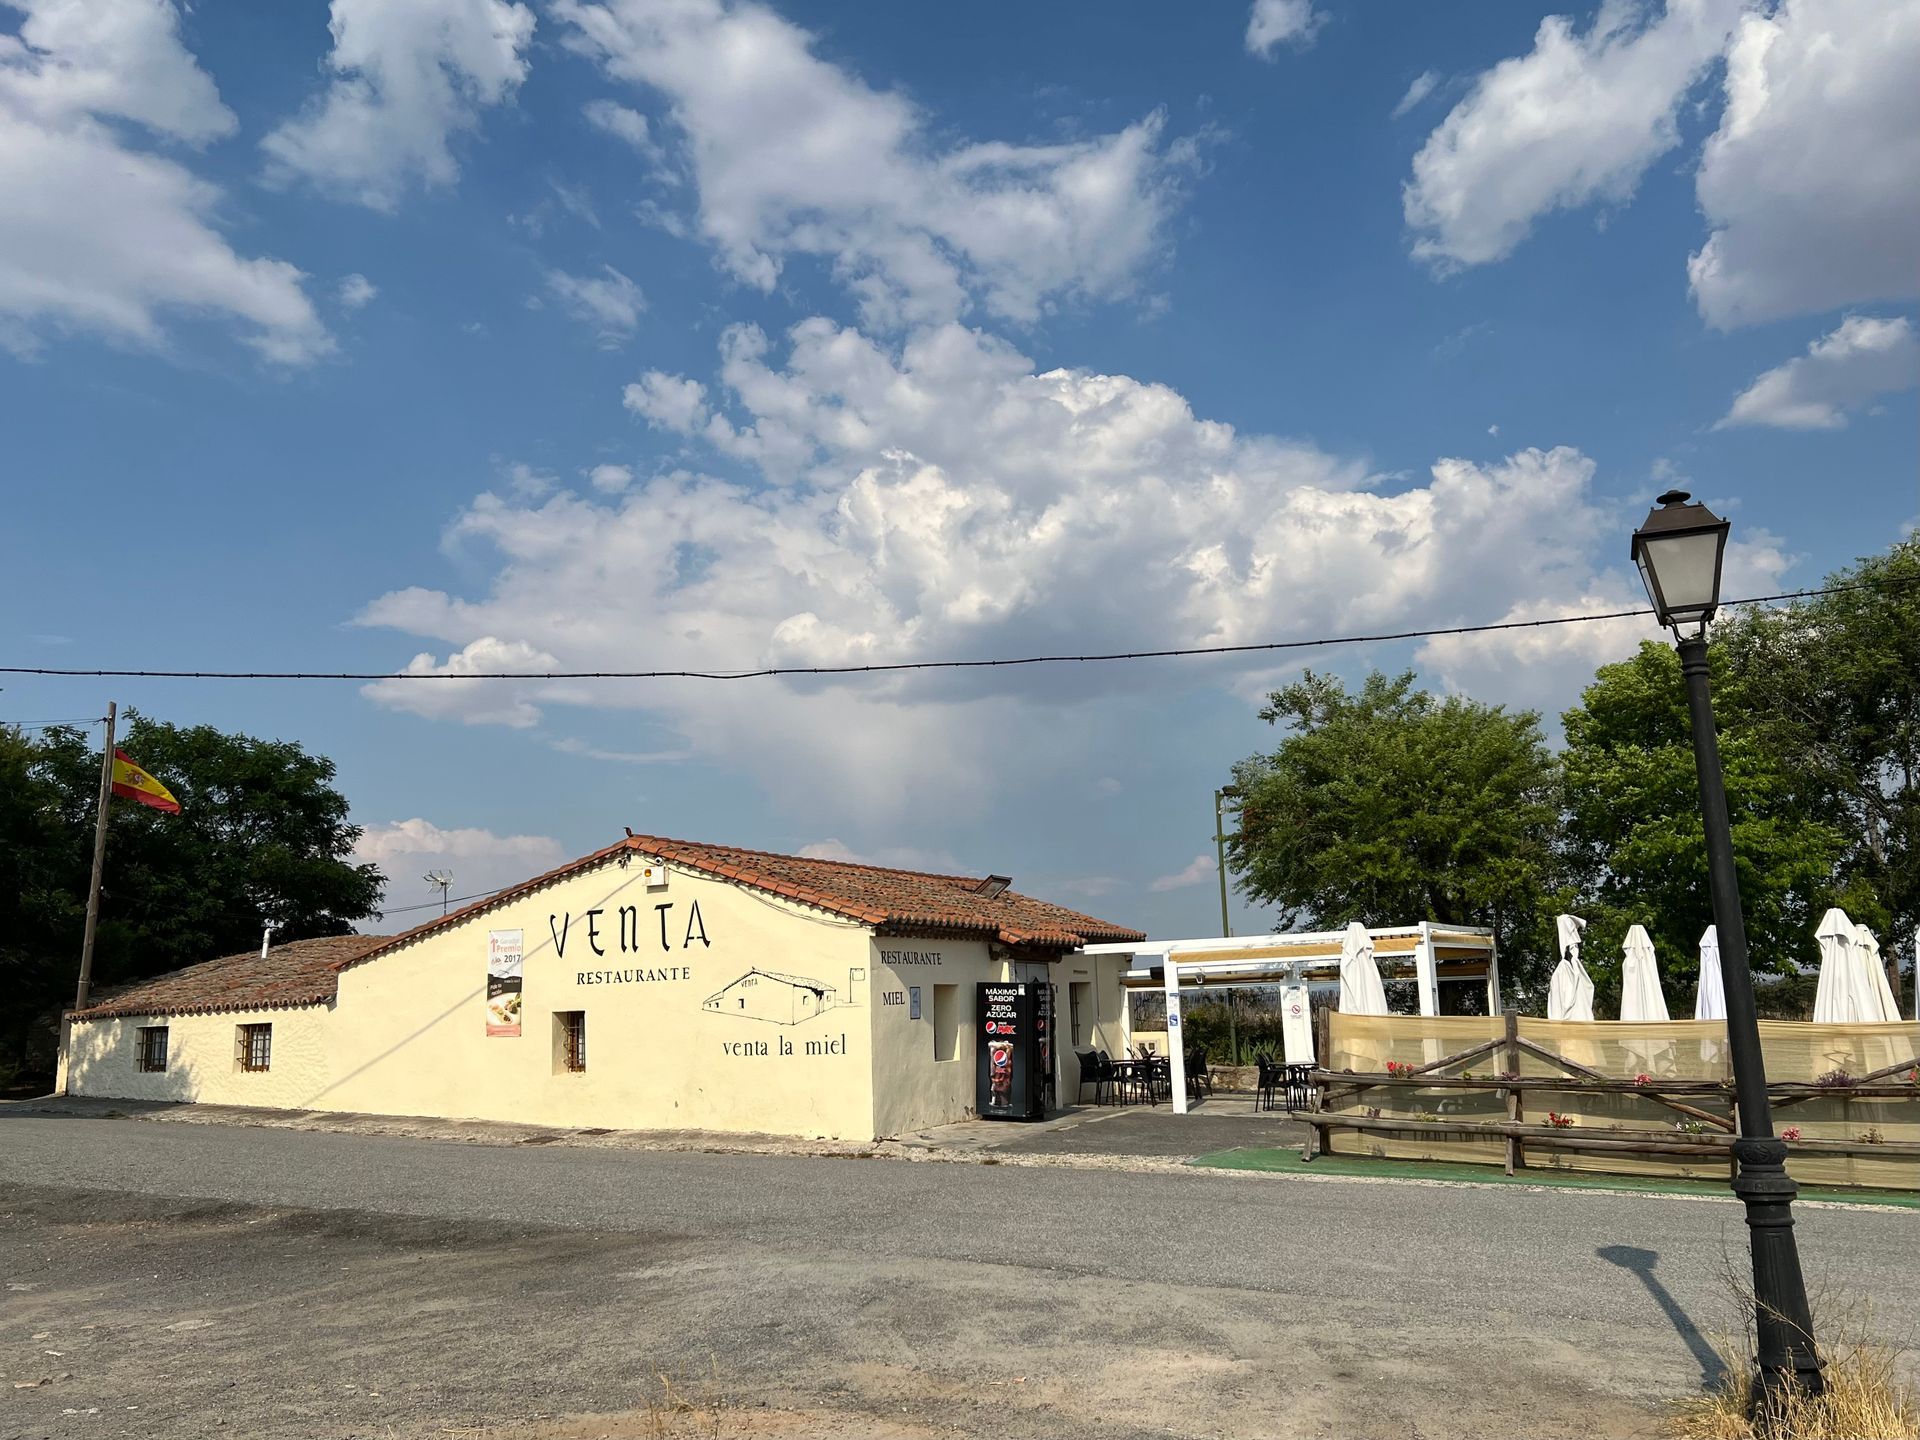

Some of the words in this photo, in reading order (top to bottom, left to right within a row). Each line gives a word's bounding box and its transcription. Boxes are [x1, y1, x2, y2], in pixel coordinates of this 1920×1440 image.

[550, 899, 711, 958] VENTA
[496, 944, 521, 953] Premio
[504, 954, 521, 963] 2017
[881, 951, 942, 965] RESTAURANTE
[577, 967, 690, 985] RESTAURANTE
[883, 992, 905, 1006] MIEL
[985, 988, 1017, 996] MÁXIMO
[723, 1040, 768, 1056] venta
[779, 1035, 793, 1055] la
[805, 1033, 846, 1055] miel
